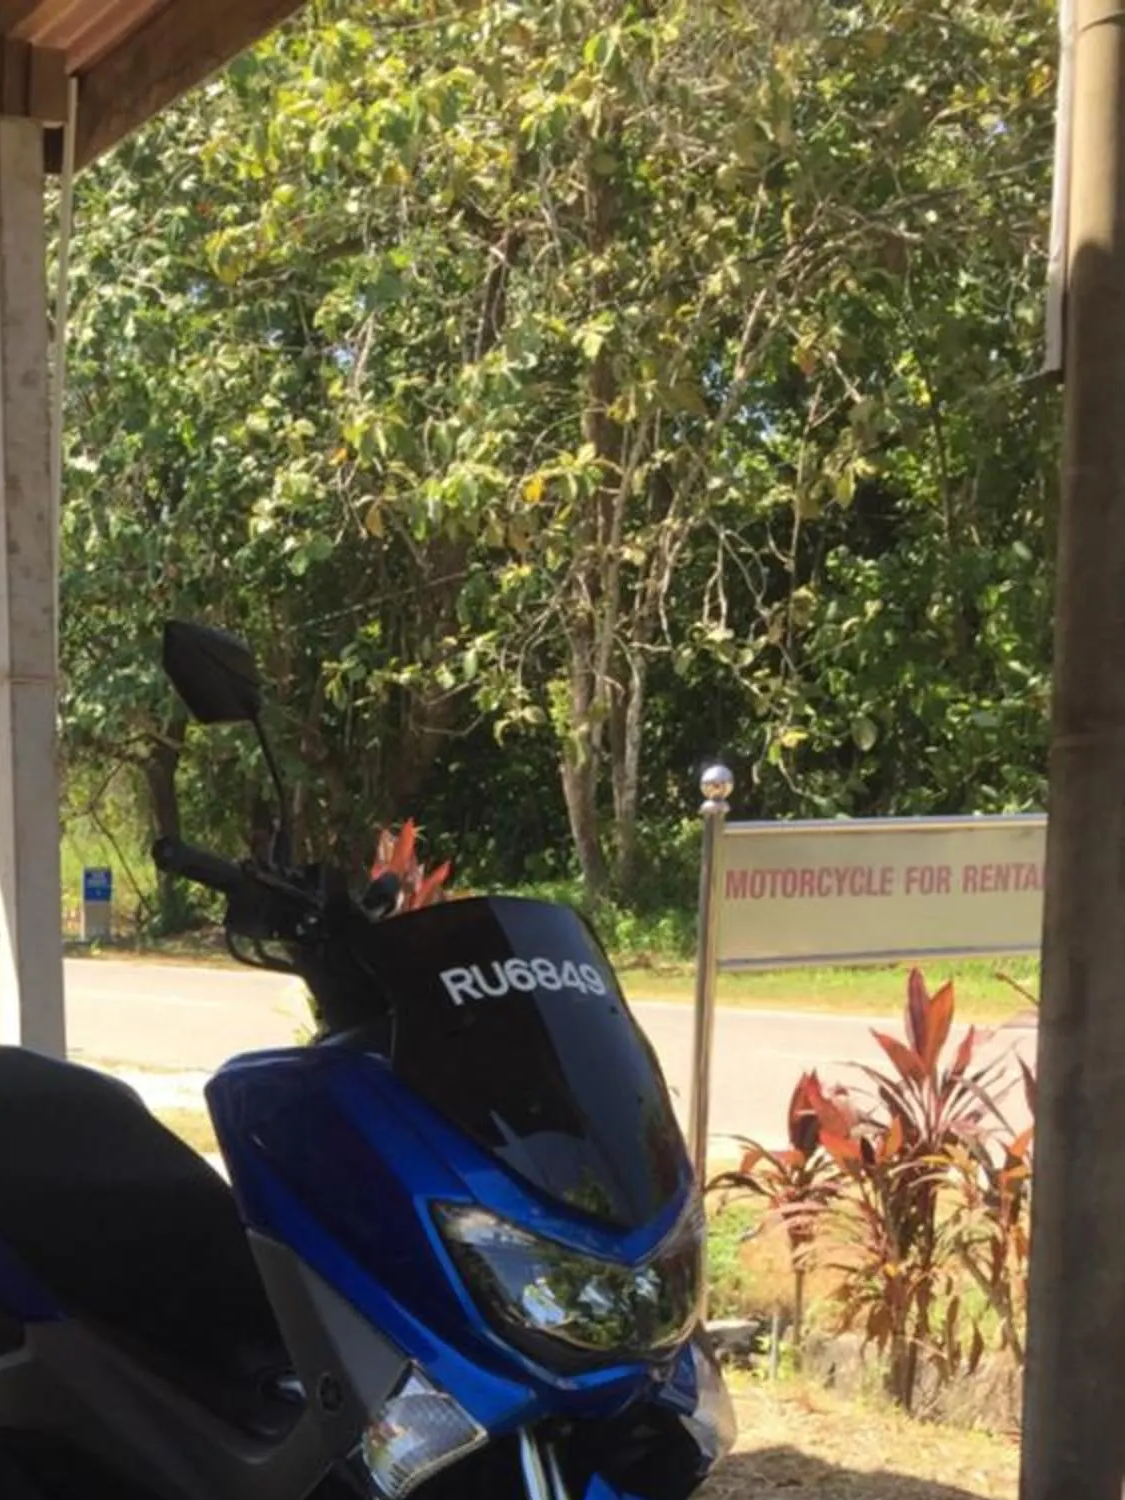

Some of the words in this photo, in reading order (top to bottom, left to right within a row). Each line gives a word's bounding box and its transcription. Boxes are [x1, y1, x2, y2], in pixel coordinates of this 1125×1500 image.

[725, 866, 894, 899] MOTORCYCLE
[905, 865, 951, 895] FOR
[962, 862, 1043, 893] RENTA
[439, 957, 607, 1005] RU6849
